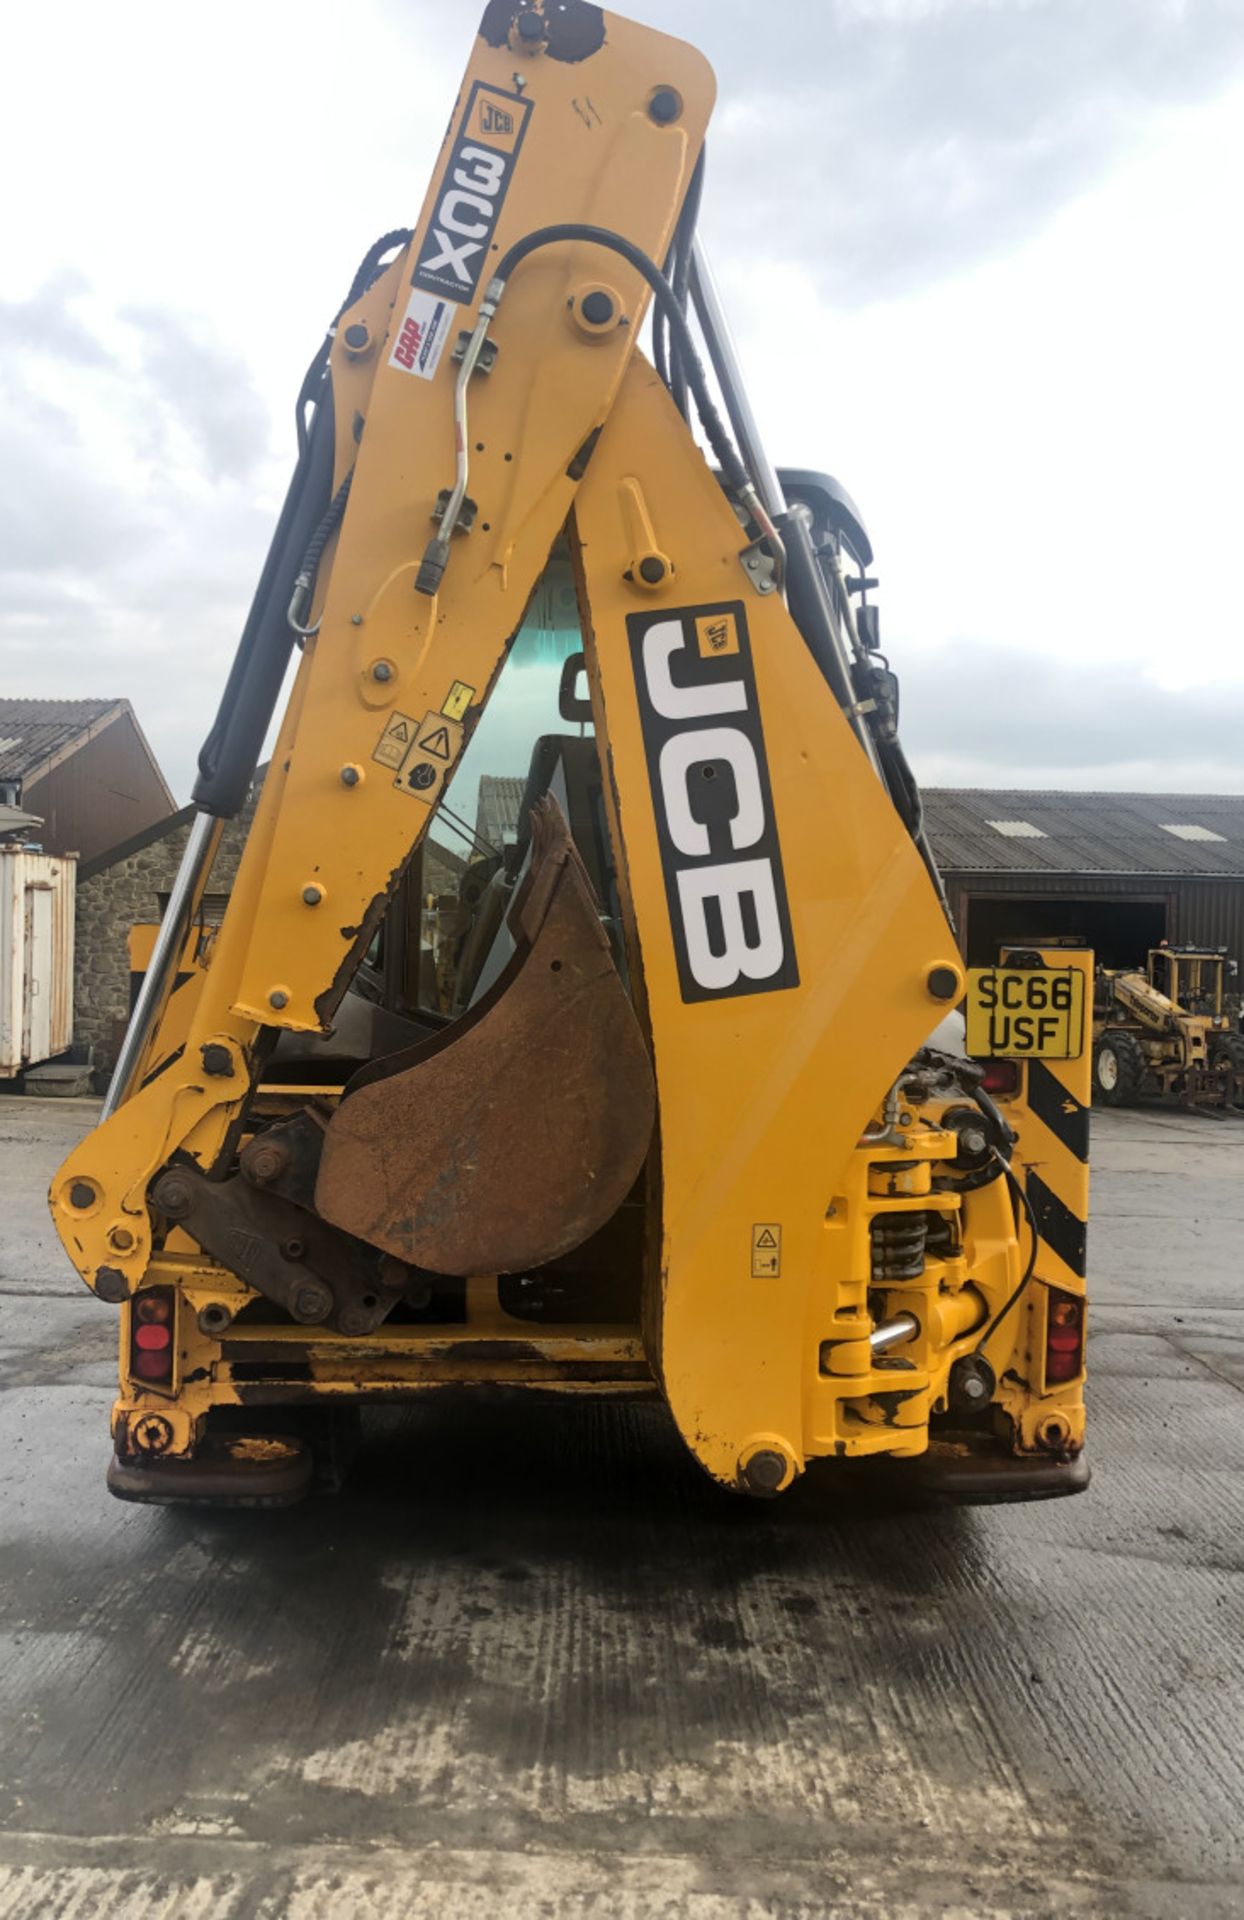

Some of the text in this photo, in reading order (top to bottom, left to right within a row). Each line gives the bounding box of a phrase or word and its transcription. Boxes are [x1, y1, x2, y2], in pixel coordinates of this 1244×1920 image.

[483, 105, 512, 133] JCB
[420, 147, 505, 285] 3CX
[419, 271, 470, 292] CONTRACTOR
[394, 317, 421, 370] GAP
[642, 620, 784, 990] JCB
[978, 975, 1072, 1010] SC66
[989, 1016, 1059, 1051] USF
